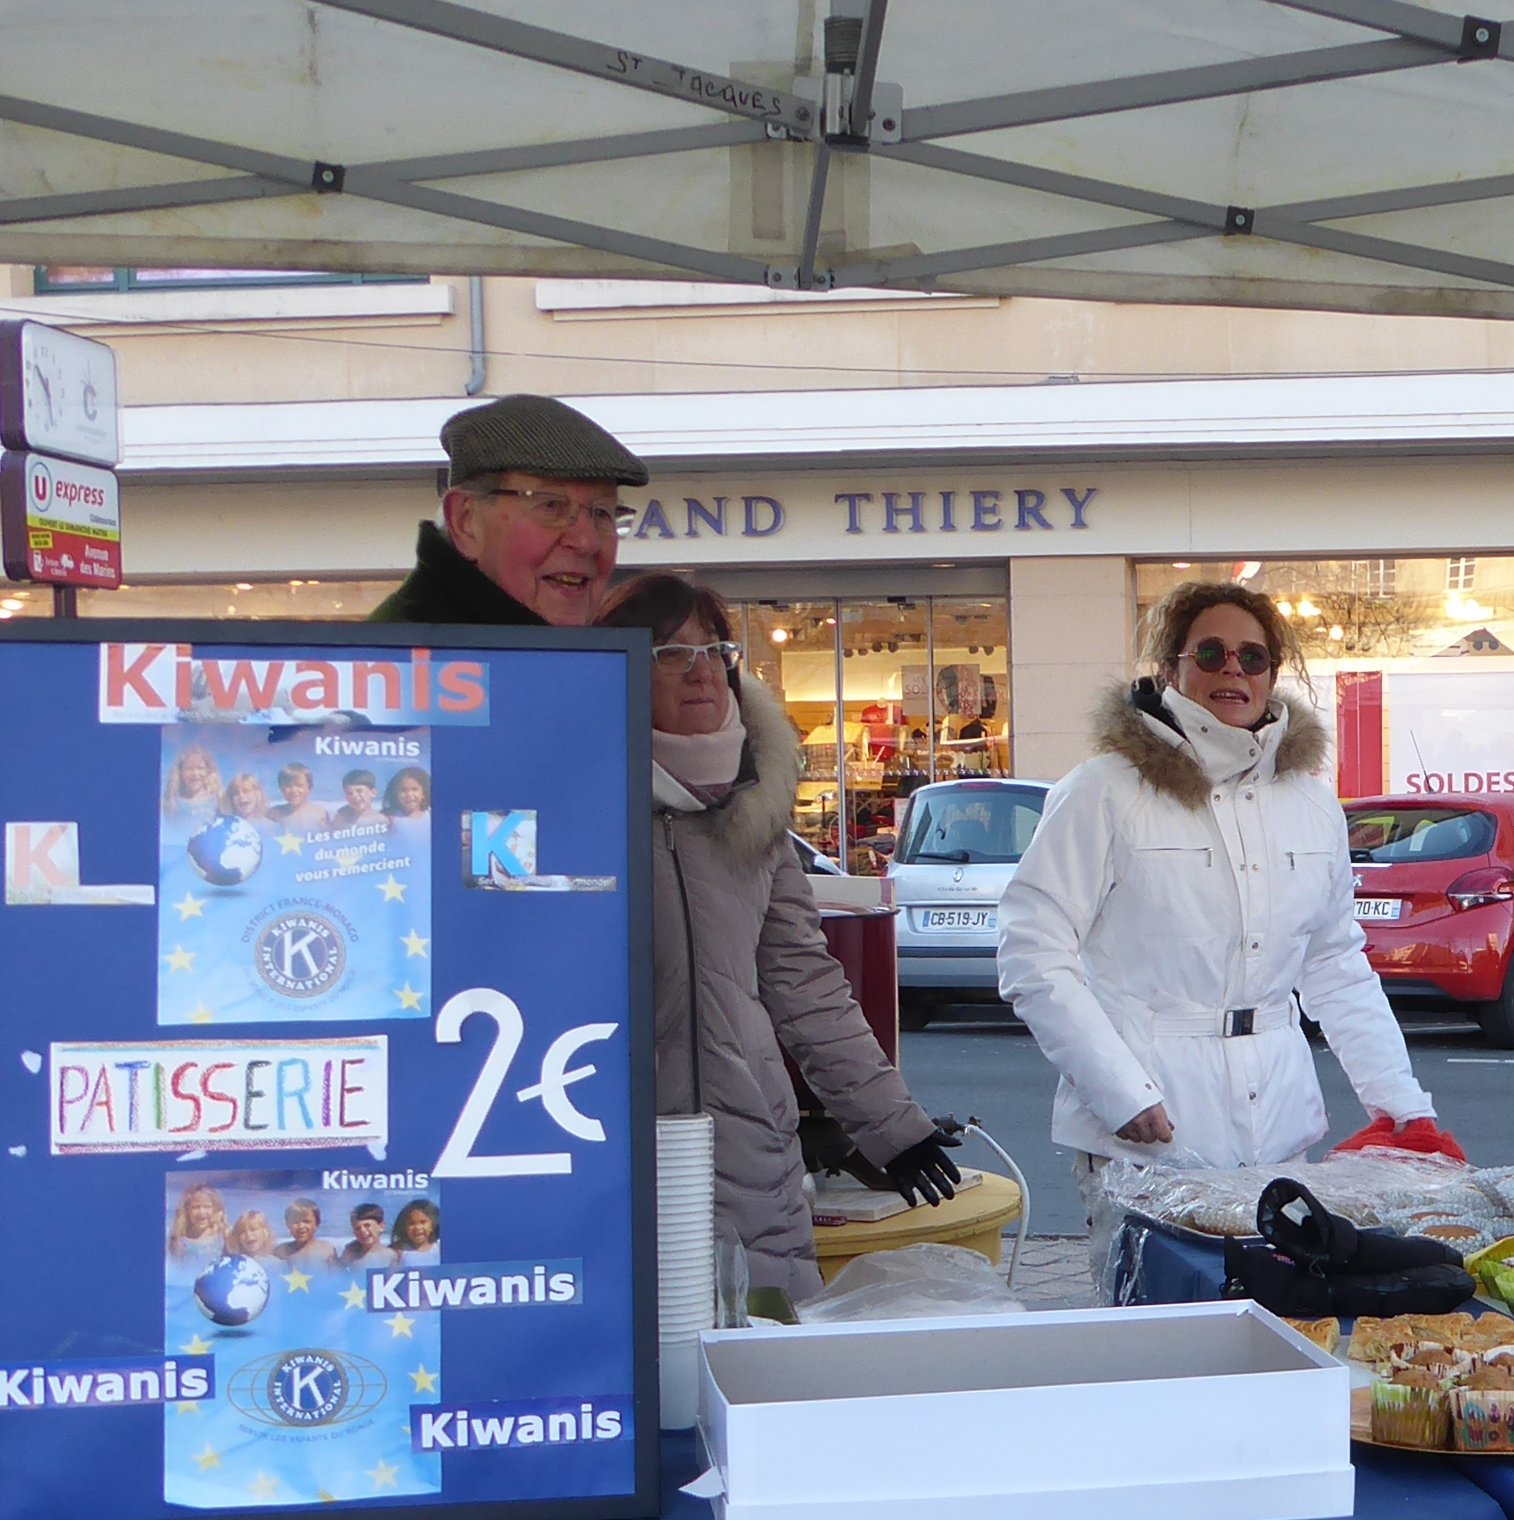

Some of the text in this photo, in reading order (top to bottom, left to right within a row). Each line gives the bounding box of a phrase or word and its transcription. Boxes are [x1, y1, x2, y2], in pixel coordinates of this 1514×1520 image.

[35, 475, 104, 507] U express
[634, 487, 1099, 539] AND THIERY
[105, 643, 486, 712] Kiwanis
[316, 736, 420, 756] Kiwanis
[307, 823, 388, 843] Les enfants
[315, 841, 385, 861] du monde
[472, 812, 529, 876] K
[14, 825, 70, 887] K
[296, 856, 411, 882] vous remercient
[241, 903, 276, 944] DISTRICT
[271, 918, 330, 937] KIWANIS
[1356, 901, 1391, 916] 70-KC
[262, 946, 338, 990] INTERNATIONAL
[283, 930, 319, 979] K
[57, 1058, 371, 1134] PATISSERIE
[432, 987, 618, 1178] 2€
[323, 1169, 429, 1189] Kiwanis
[372, 1266, 576, 1308] Kiwanis
[0, 1361, 209, 1404] Kiwanis
[281, 1355, 334, 1373] KIWANIS
[274, 1380, 341, 1420] INTERNATIONAL
[292, 1366, 324, 1411] K
[420, 1404, 622, 1449] Kiwanis
